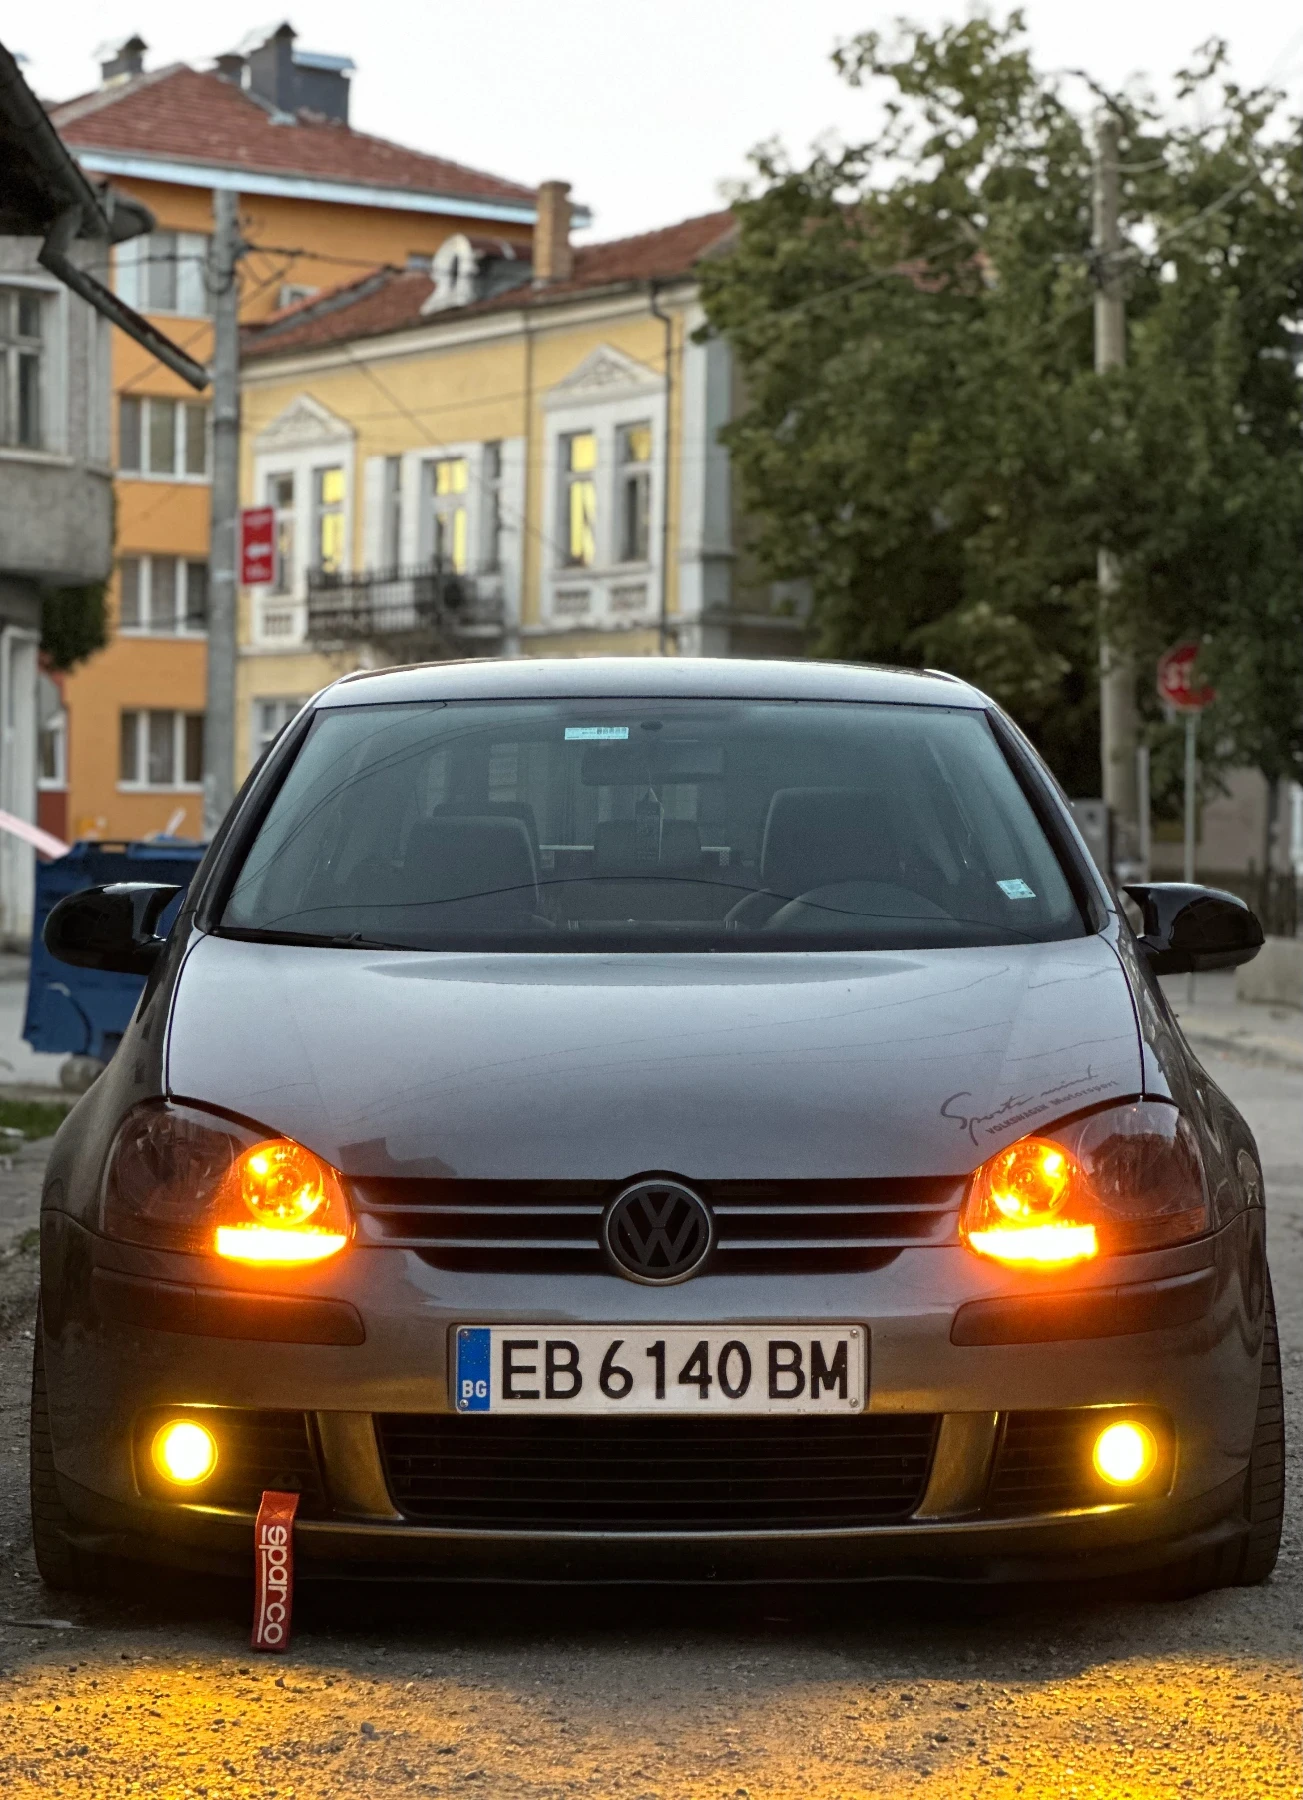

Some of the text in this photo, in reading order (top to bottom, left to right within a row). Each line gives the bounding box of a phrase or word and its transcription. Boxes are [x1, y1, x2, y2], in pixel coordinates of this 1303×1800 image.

[985, 1079, 1119, 1135] VOLKSWAGEN Motorsport
[461, 1379, 488, 1398] BG
[502, 1340, 848, 1400] EB 6140 BM
[257, 1524, 288, 1645] sparco
